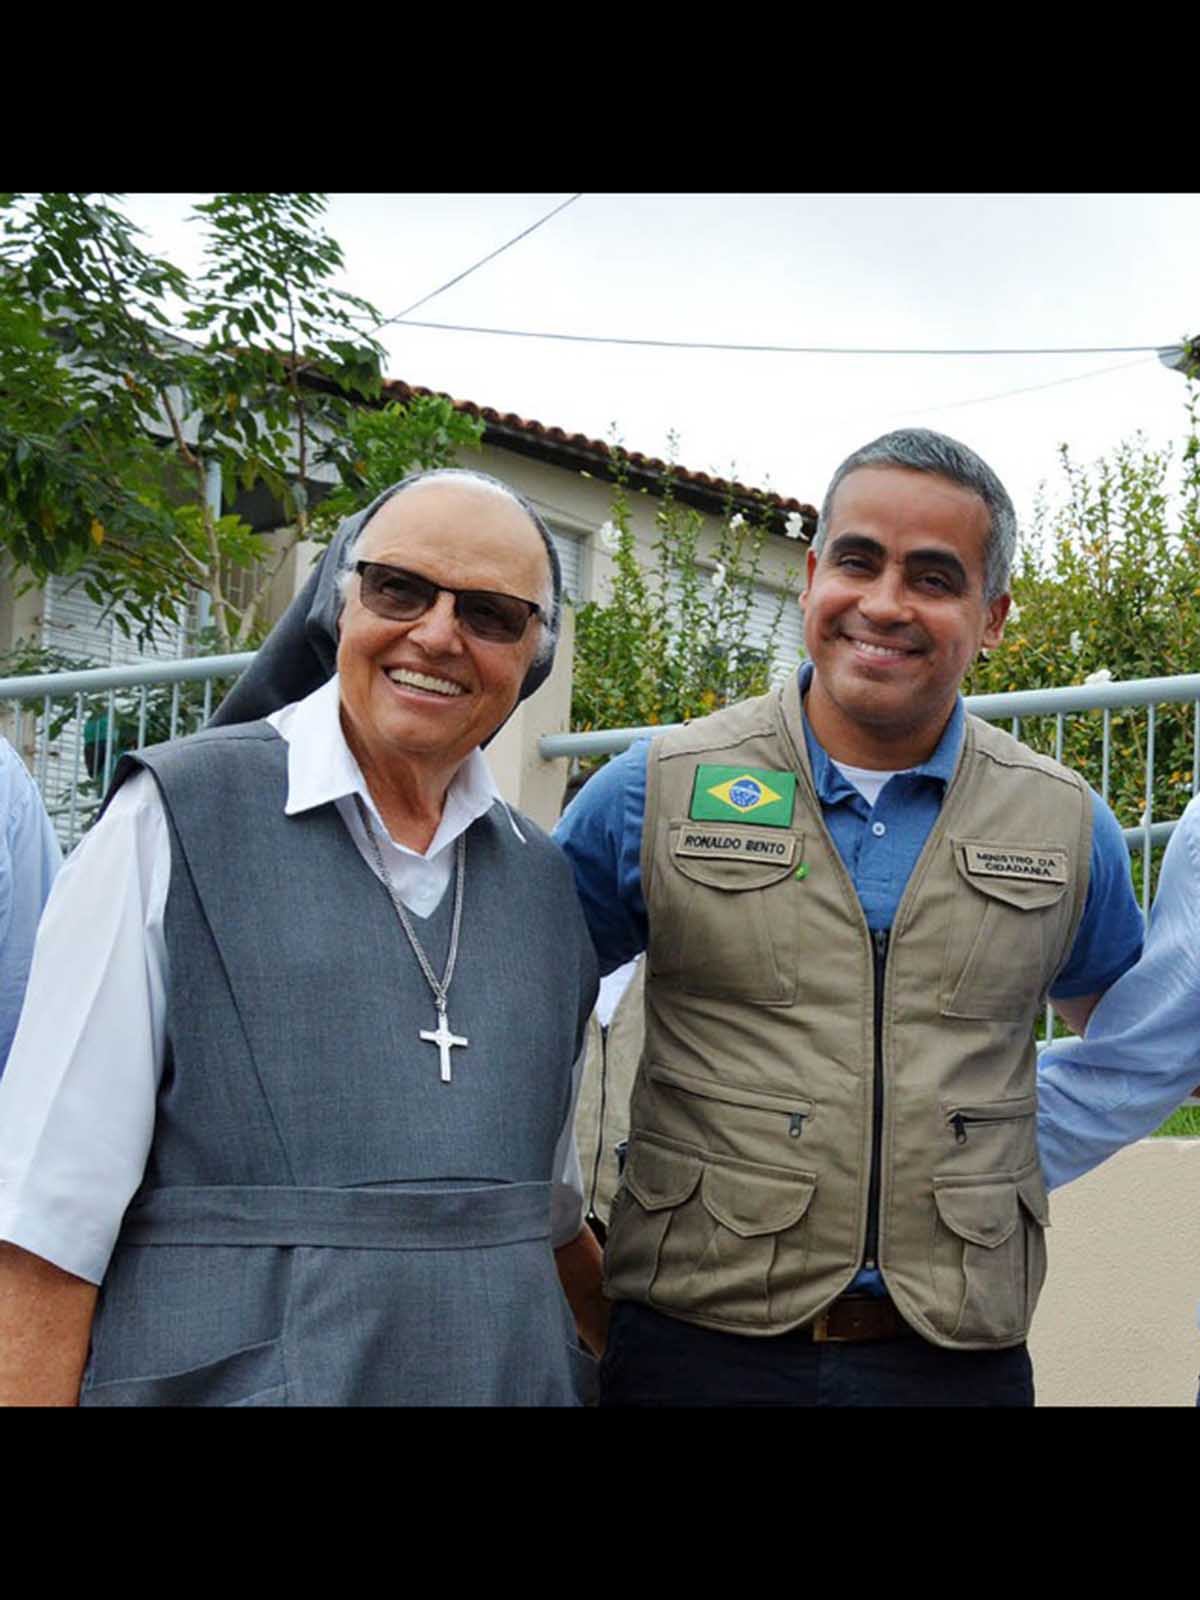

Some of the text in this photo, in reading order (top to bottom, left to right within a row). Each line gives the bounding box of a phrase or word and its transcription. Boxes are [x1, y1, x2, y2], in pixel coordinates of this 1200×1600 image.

[684, 834, 785, 855] RONALDO BENTO
[976, 852, 1056, 867] MINISTRO DA
[985, 862, 1051, 876] CIDADANIA
